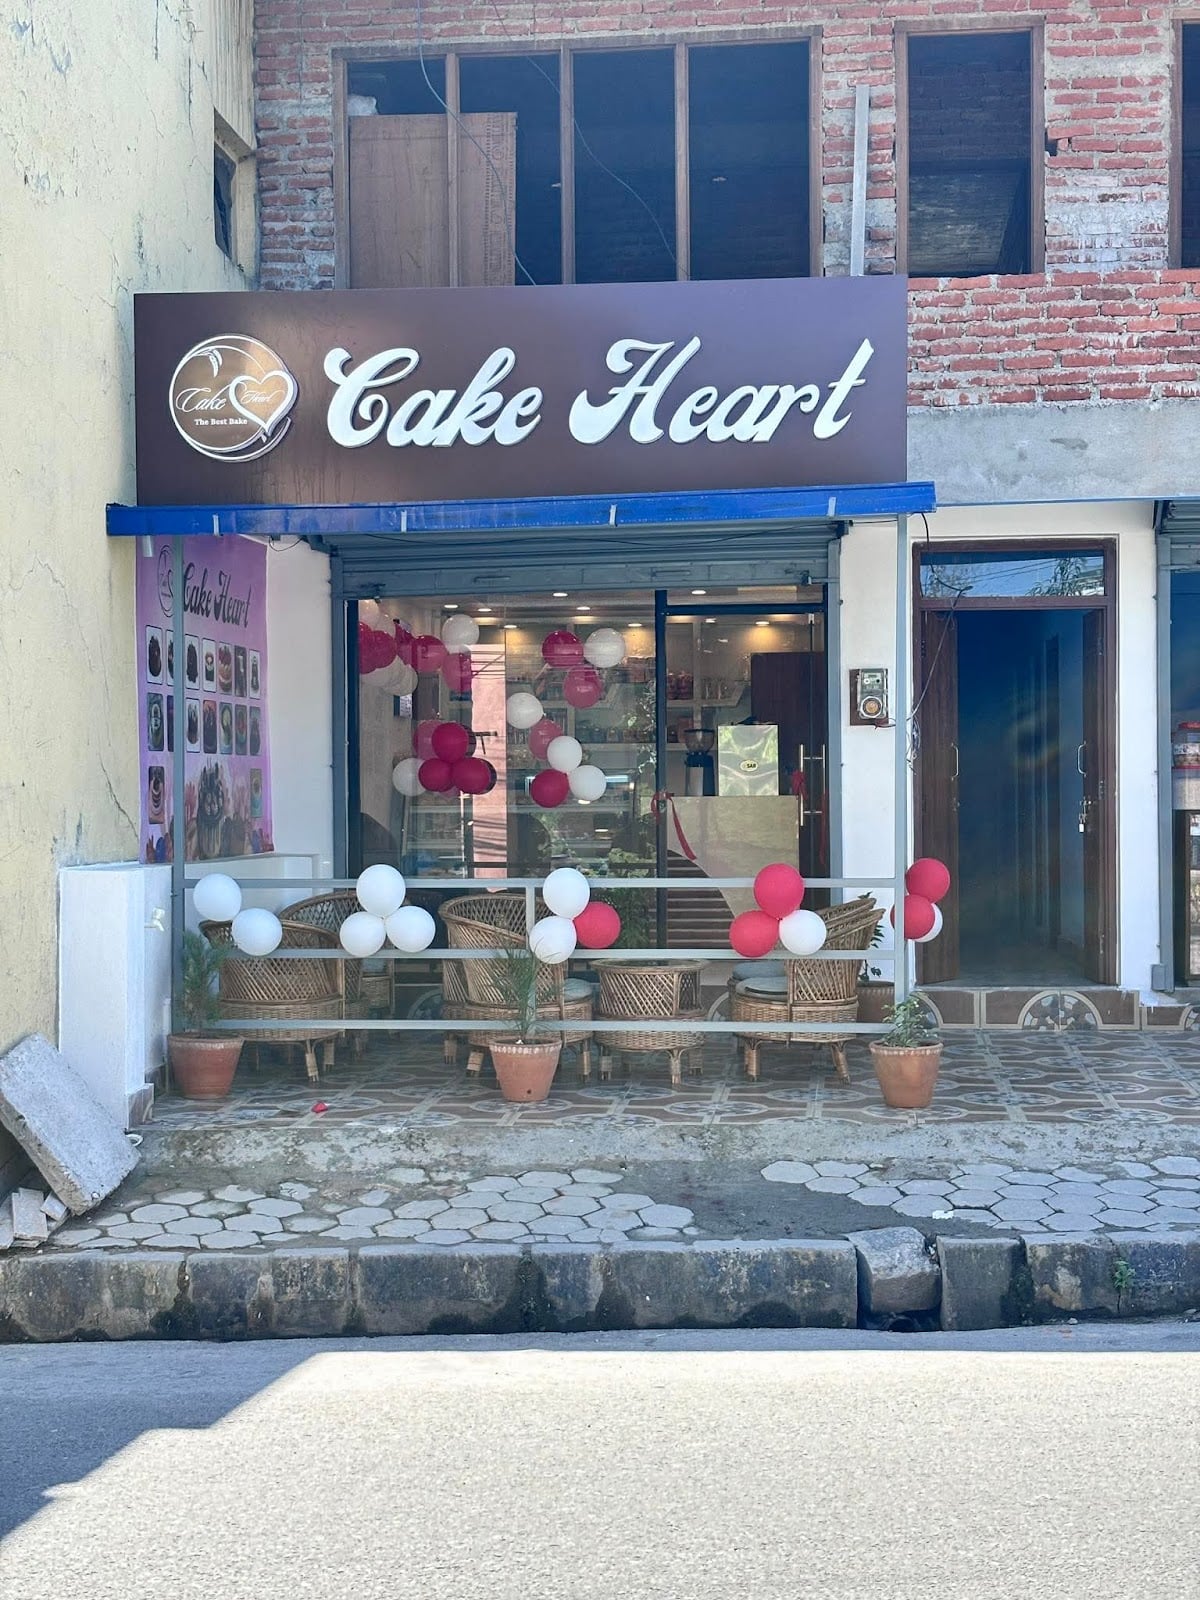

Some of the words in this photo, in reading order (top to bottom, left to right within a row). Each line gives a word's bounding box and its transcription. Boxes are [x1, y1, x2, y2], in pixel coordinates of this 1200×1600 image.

[175, 383, 231, 413] Cake
[323, 346, 544, 449] Cake
[568, 335, 875, 446] Heart
[194, 418, 209, 426] The
[211, 418, 228, 426] Best
[229, 418, 248, 426] Bake
[214, 570, 252, 628] Heart
